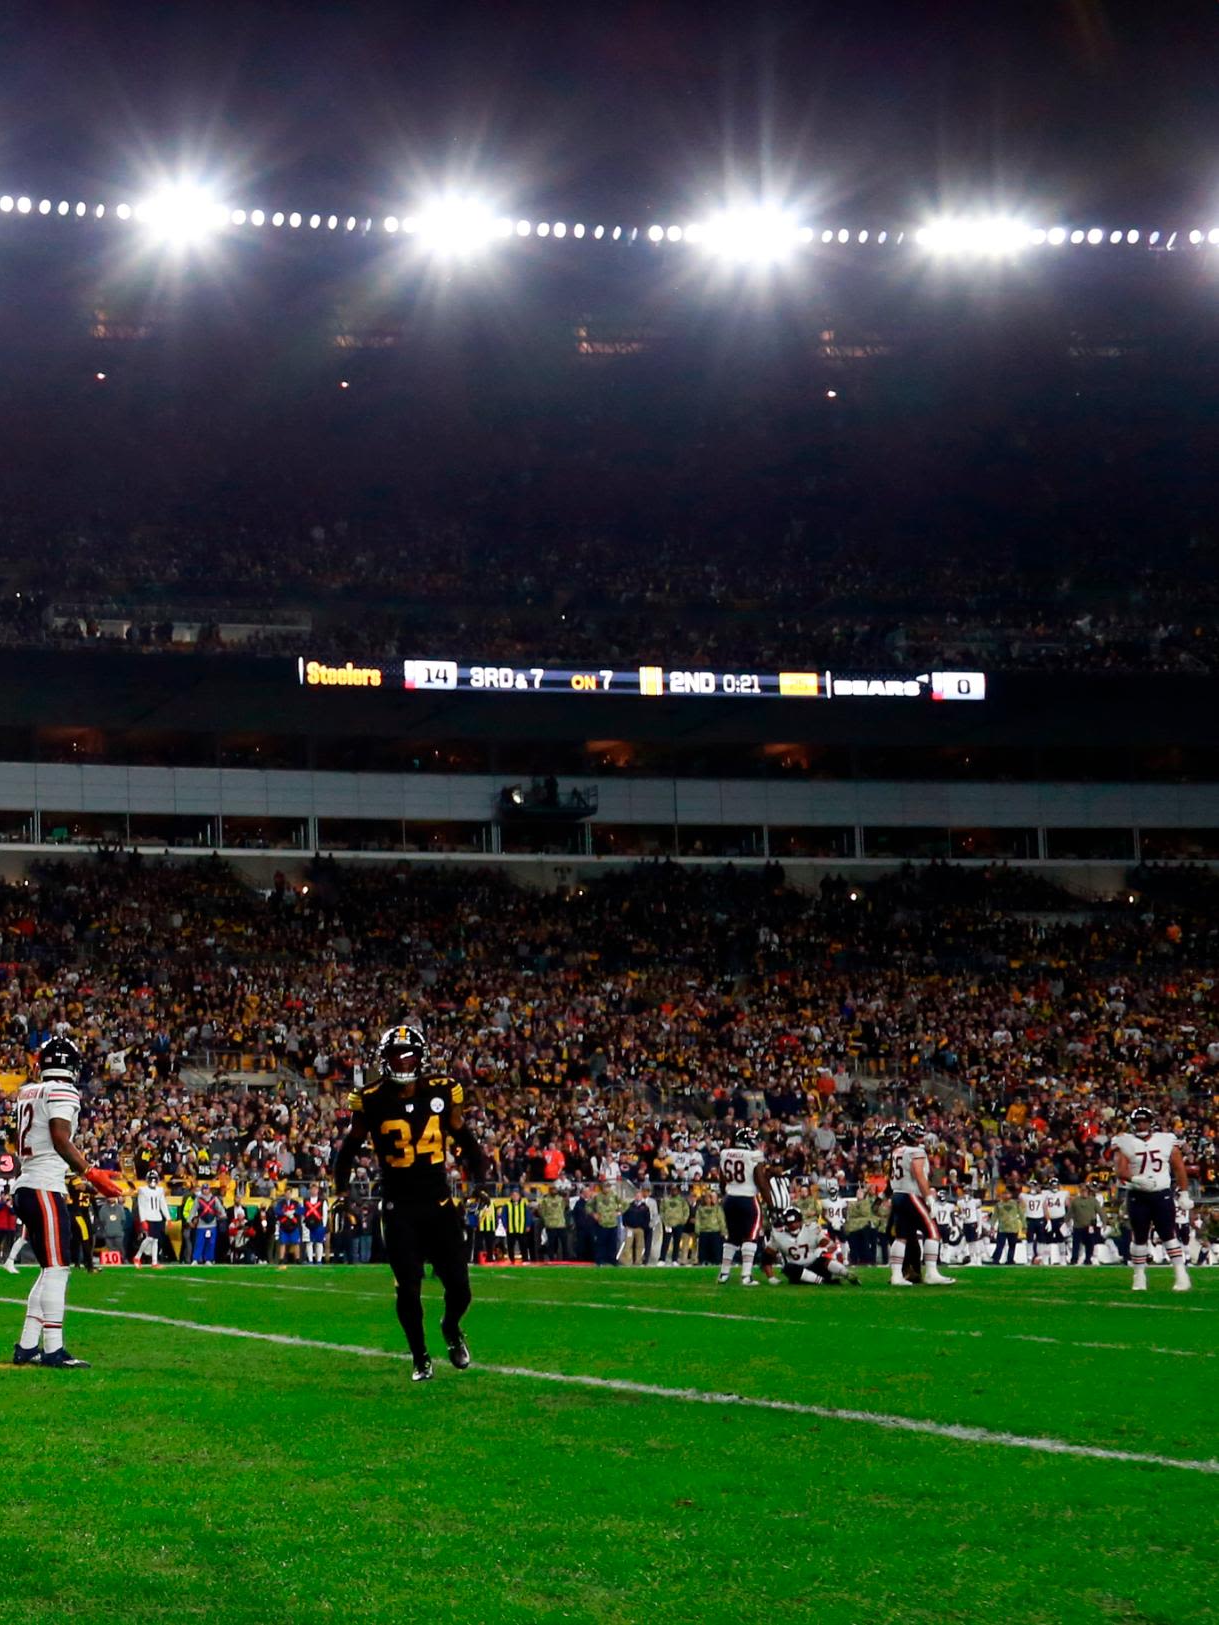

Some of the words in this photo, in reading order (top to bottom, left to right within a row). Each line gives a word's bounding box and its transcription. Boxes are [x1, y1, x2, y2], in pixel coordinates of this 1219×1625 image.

[306, 661, 381, 686] Steelers
[425, 667, 448, 684] 14
[571, 675, 596, 690] ON
[600, 670, 613, 690] 7
[669, 671, 715, 693] 2ND
[723, 674, 761, 693] 0:21
[957, 679, 971, 694] 0
[380, 1114, 444, 1168] 34
[723, 1159, 746, 1184] 68
[1135, 1150, 1163, 1176] 75
[150, 1196, 158, 1211] 11
[1028, 1200, 1041, 1212] 87
[1047, 1197, 1061, 1208] 64
[937, 1210, 947, 1221] 17
[104, 1253, 119, 1265] 10
[788, 1244, 809, 1261] 67
